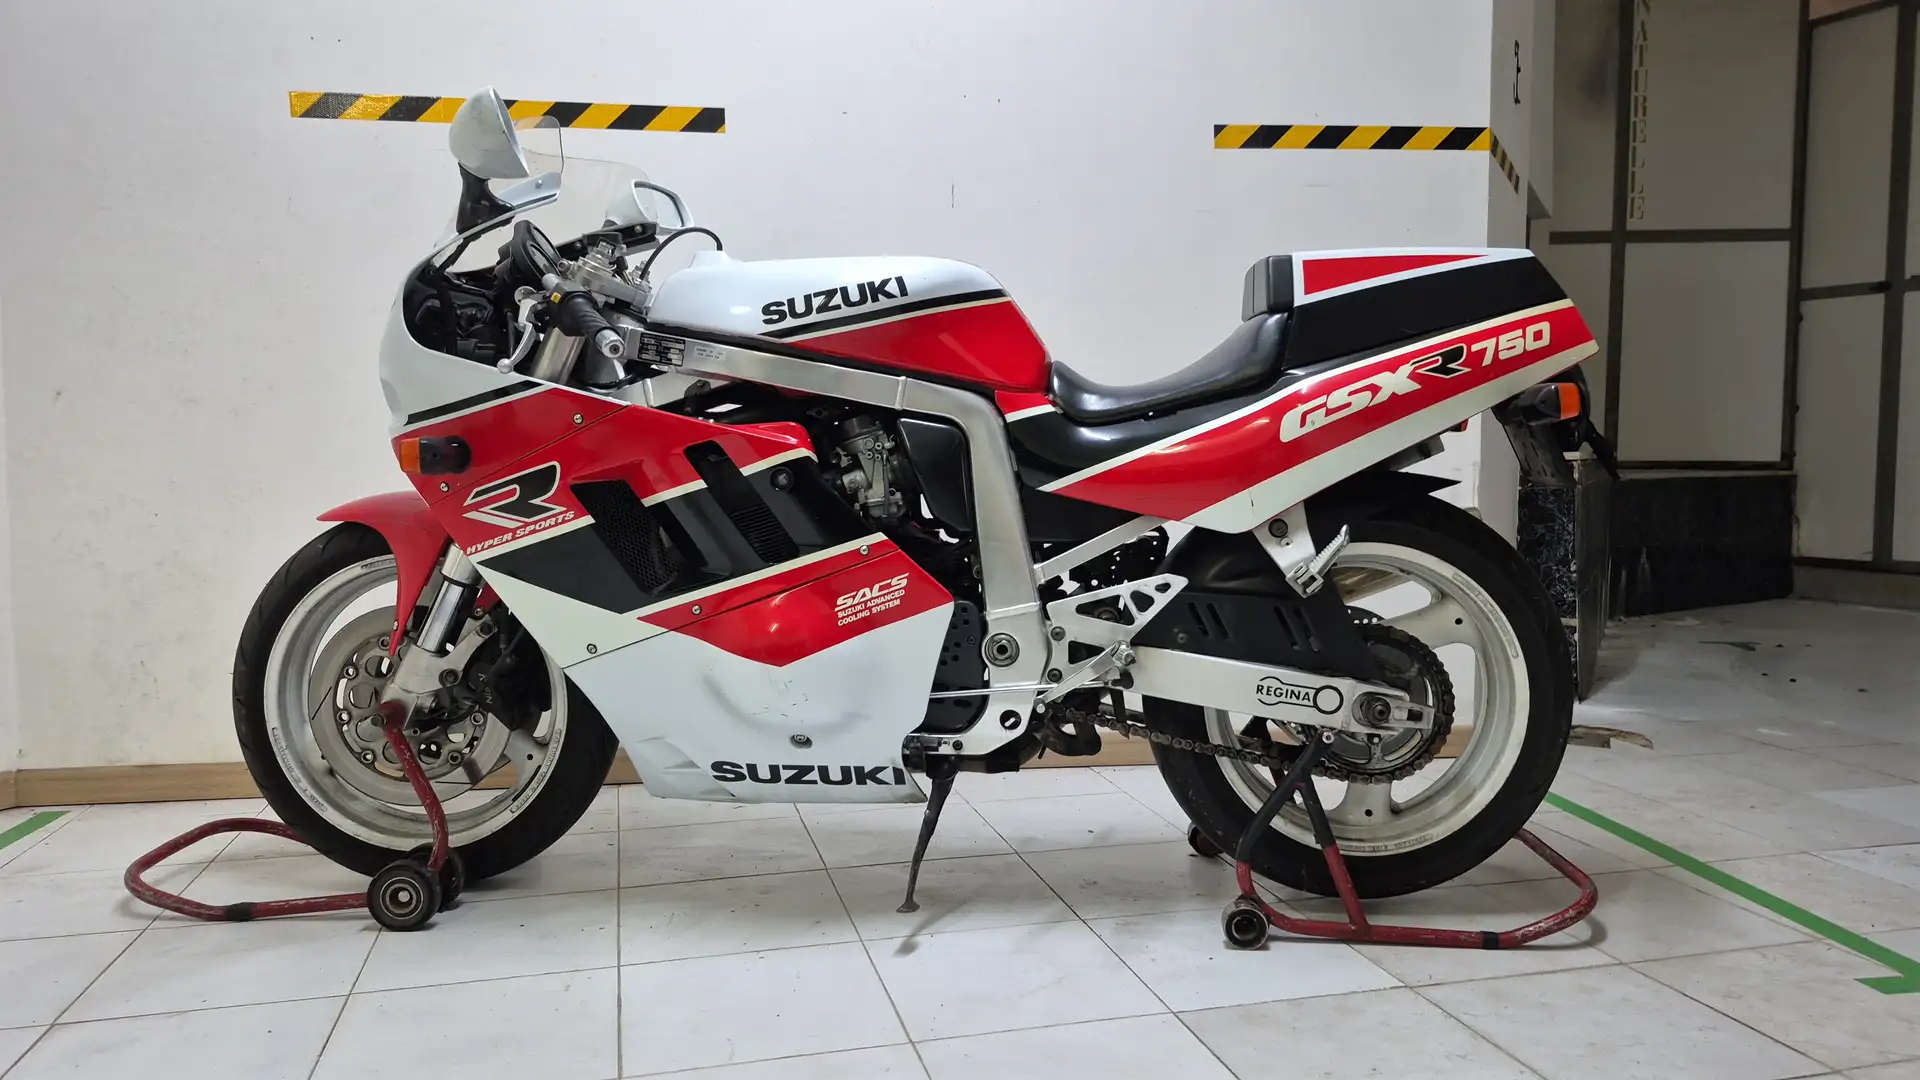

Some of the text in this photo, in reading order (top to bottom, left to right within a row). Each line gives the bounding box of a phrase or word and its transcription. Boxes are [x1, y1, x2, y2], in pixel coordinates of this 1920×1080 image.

[761, 275, 909, 325] SUZUKI
[1471, 320, 1551, 368] 750
[466, 510, 575, 555] HYPER SPORTS
[834, 572, 910, 612] SACS
[837, 589, 906, 619] SUZUKI ADVANCED
[837, 598, 901, 627] COOLING SYSTEM
[1256, 684, 1311, 702] REGINA
[710, 760, 906, 786] SUZUKI
